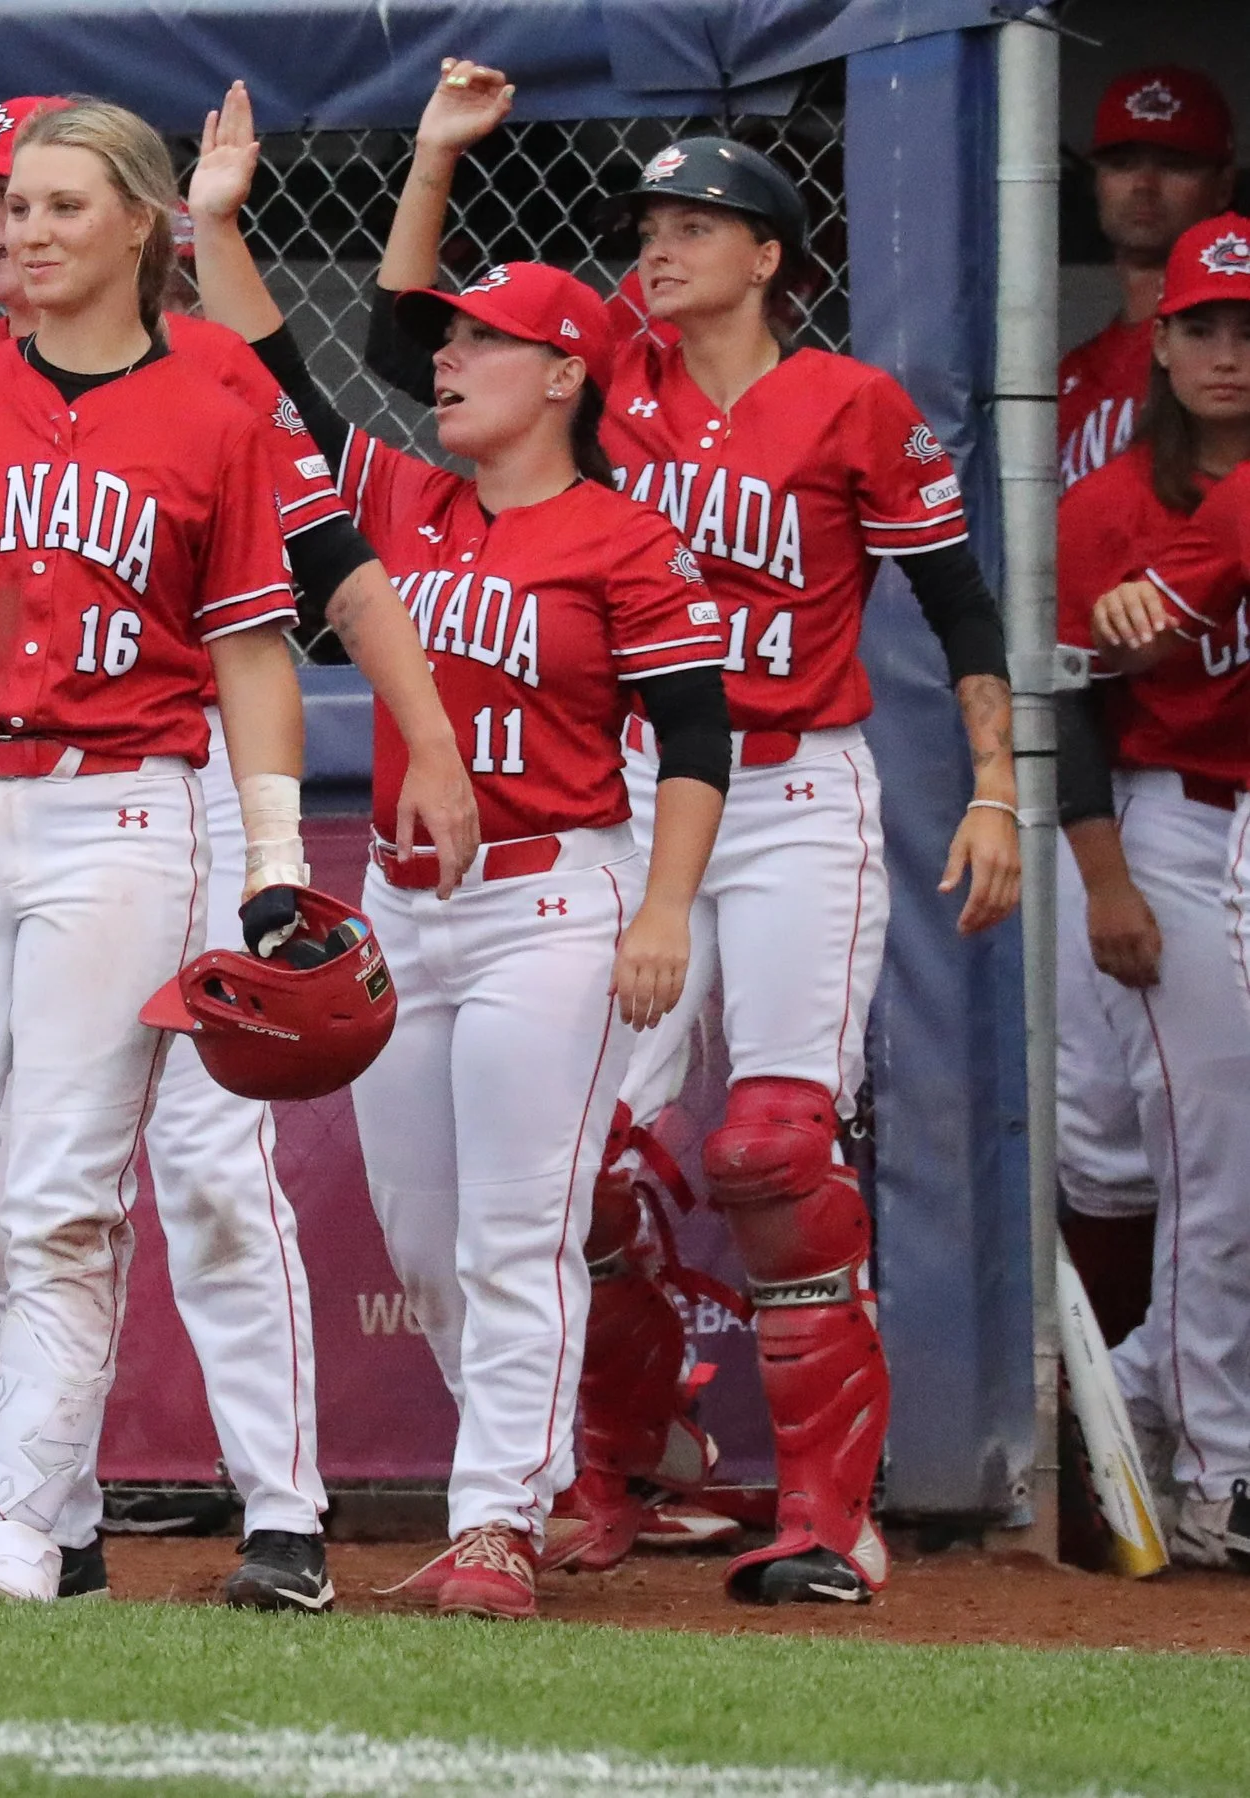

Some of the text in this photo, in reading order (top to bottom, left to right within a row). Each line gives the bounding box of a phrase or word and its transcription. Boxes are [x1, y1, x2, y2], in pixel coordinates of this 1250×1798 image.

[75, 604, 143, 677] 16
[720, 606, 794, 677] 14
[471, 706, 526, 775] 11
